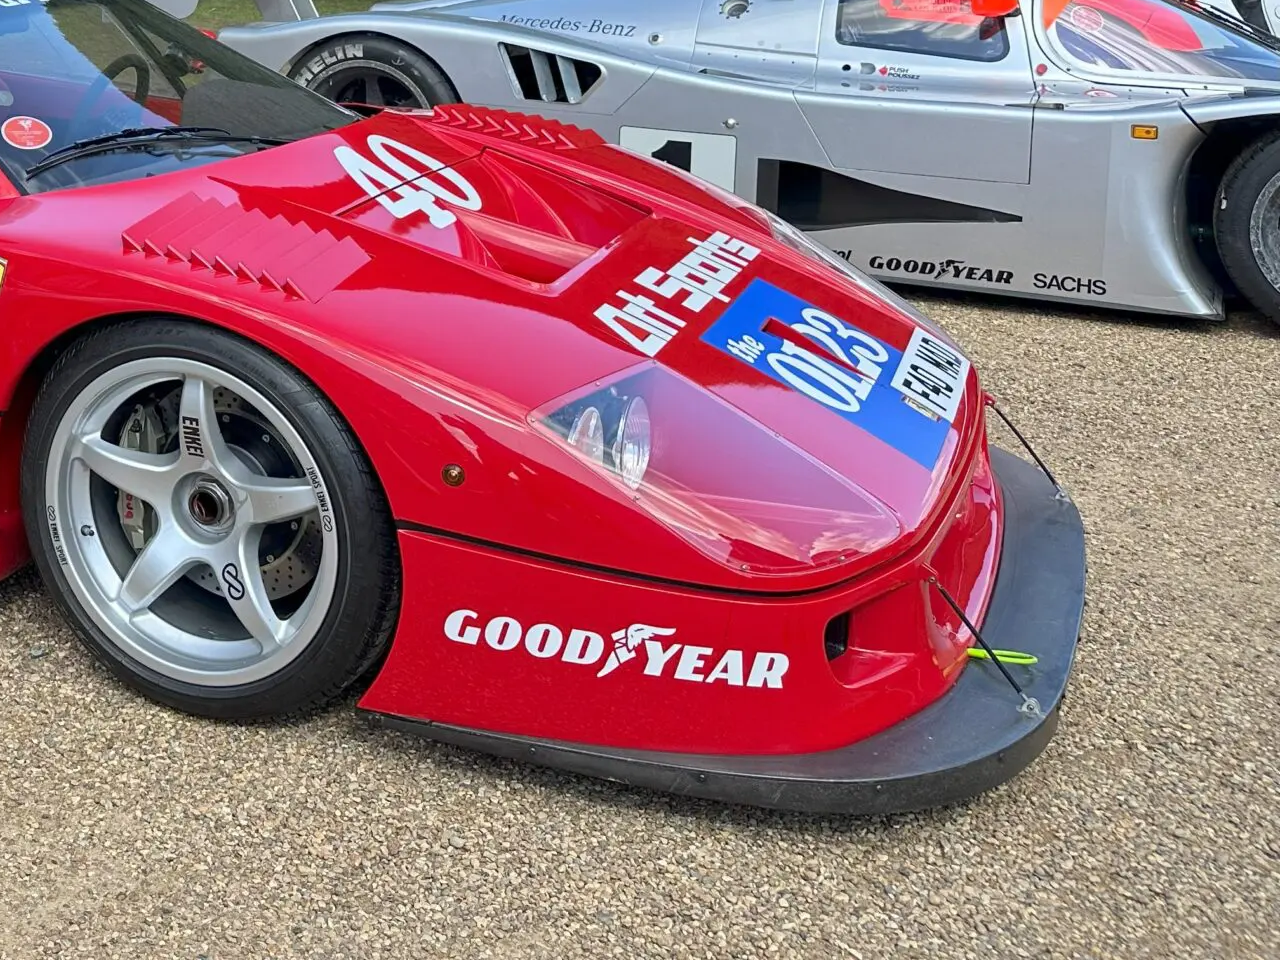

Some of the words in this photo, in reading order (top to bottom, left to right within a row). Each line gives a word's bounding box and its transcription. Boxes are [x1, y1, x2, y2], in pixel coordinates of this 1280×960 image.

[500, 14, 638, 38] Mercedes-Benz
[888, 66, 910, 74] PUSH
[333, 134, 483, 229] 40
[632, 230, 762, 313] Sports
[1032, 272, 1108, 296] SACHS
[592, 289, 688, 358] Art
[726, 334, 766, 364] the
[766, 308, 889, 413] 0123
[902, 363, 954, 412] F40
[182, 415, 205, 459] ENKEI
[55, 545, 69, 567] SPORT
